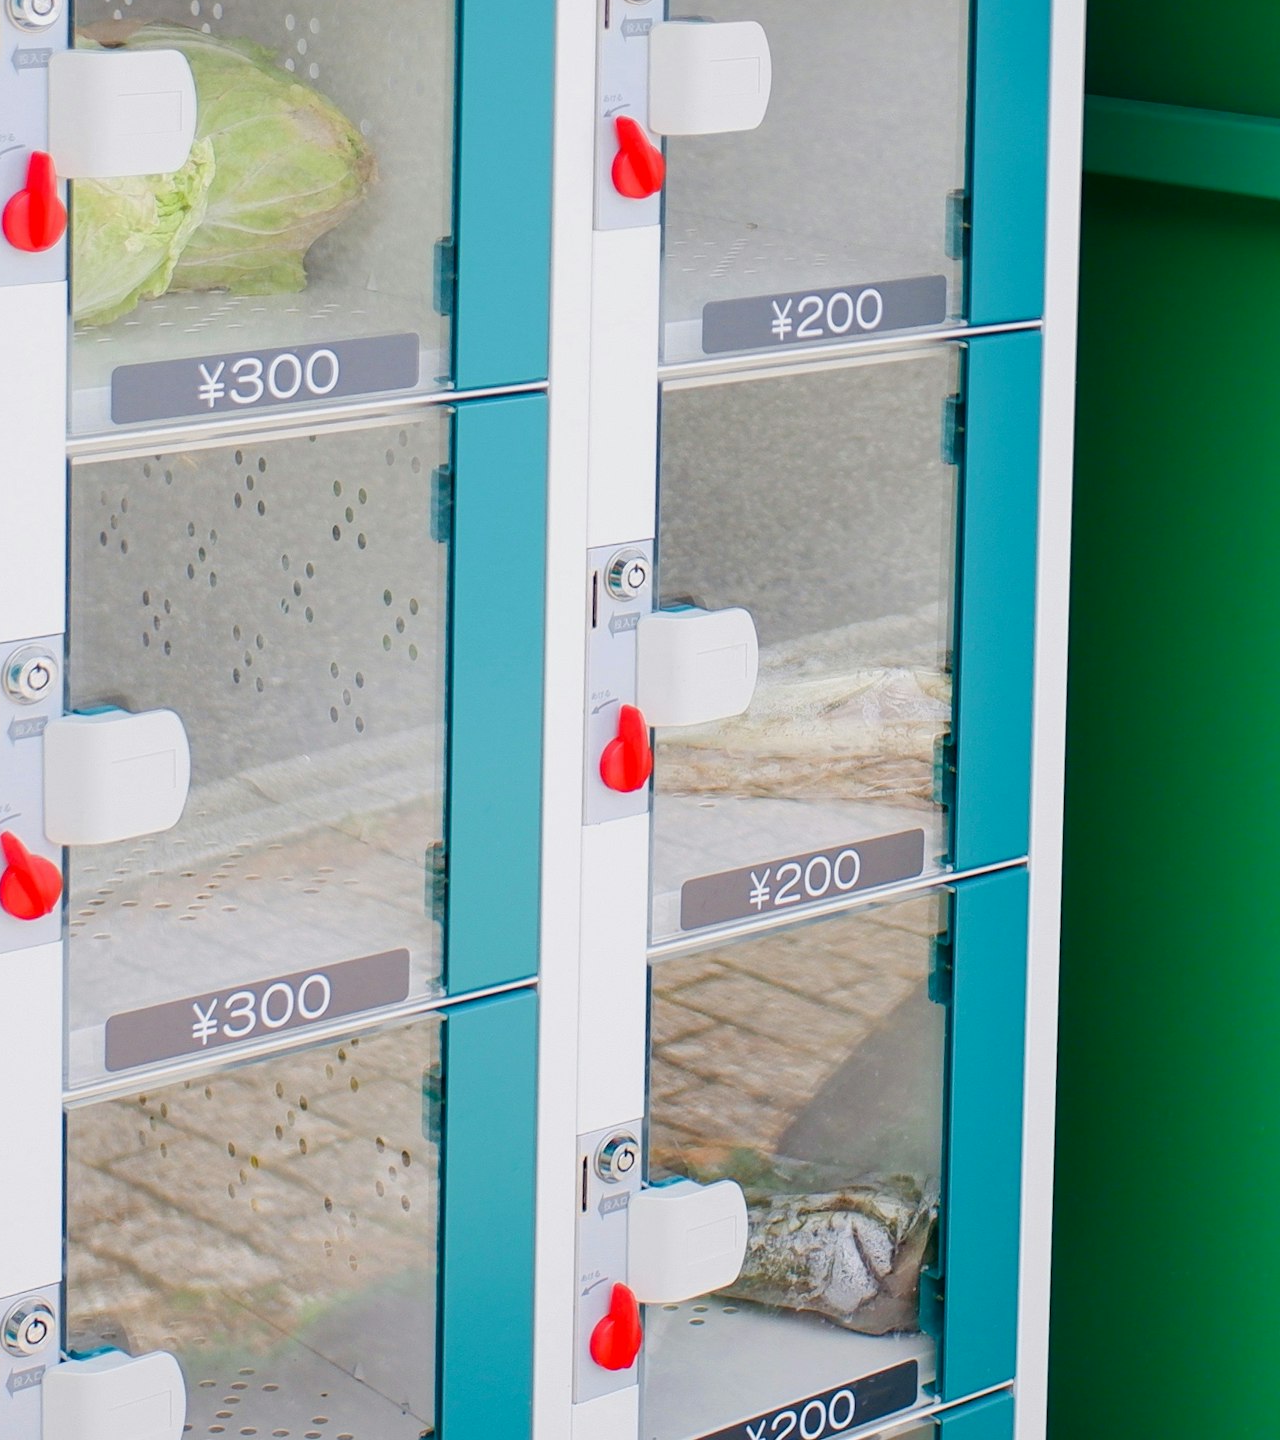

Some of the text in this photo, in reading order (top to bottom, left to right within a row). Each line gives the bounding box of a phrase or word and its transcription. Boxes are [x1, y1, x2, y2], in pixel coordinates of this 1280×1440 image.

[771, 288, 884, 341] ¥200
[197, 348, 340, 409] ¥300
[749, 849, 862, 911] ¥200
[191, 973, 332, 1046] ¥300
